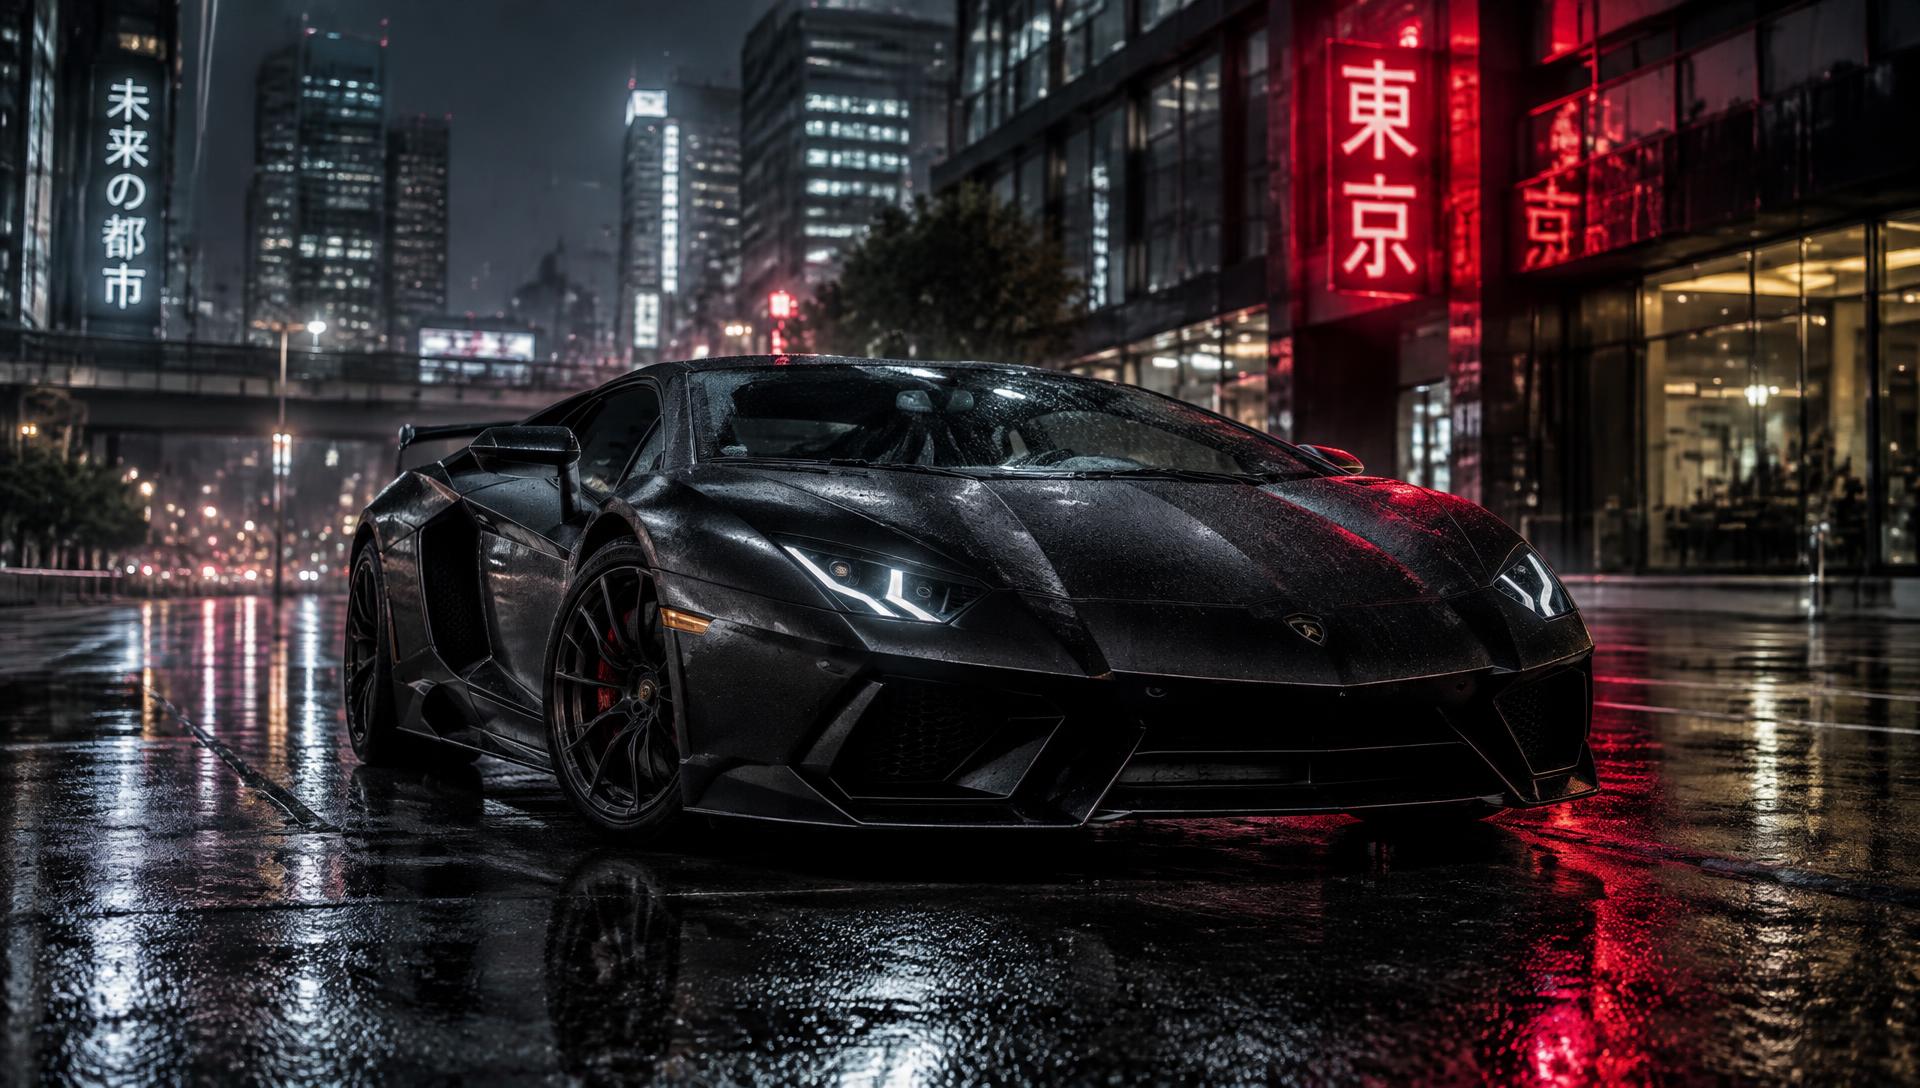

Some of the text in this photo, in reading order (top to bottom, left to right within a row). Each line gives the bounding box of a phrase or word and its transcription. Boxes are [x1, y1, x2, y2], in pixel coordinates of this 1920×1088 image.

[102, 77, 150, 310] 未来の都市
[1341, 59, 1418, 278] 東京
